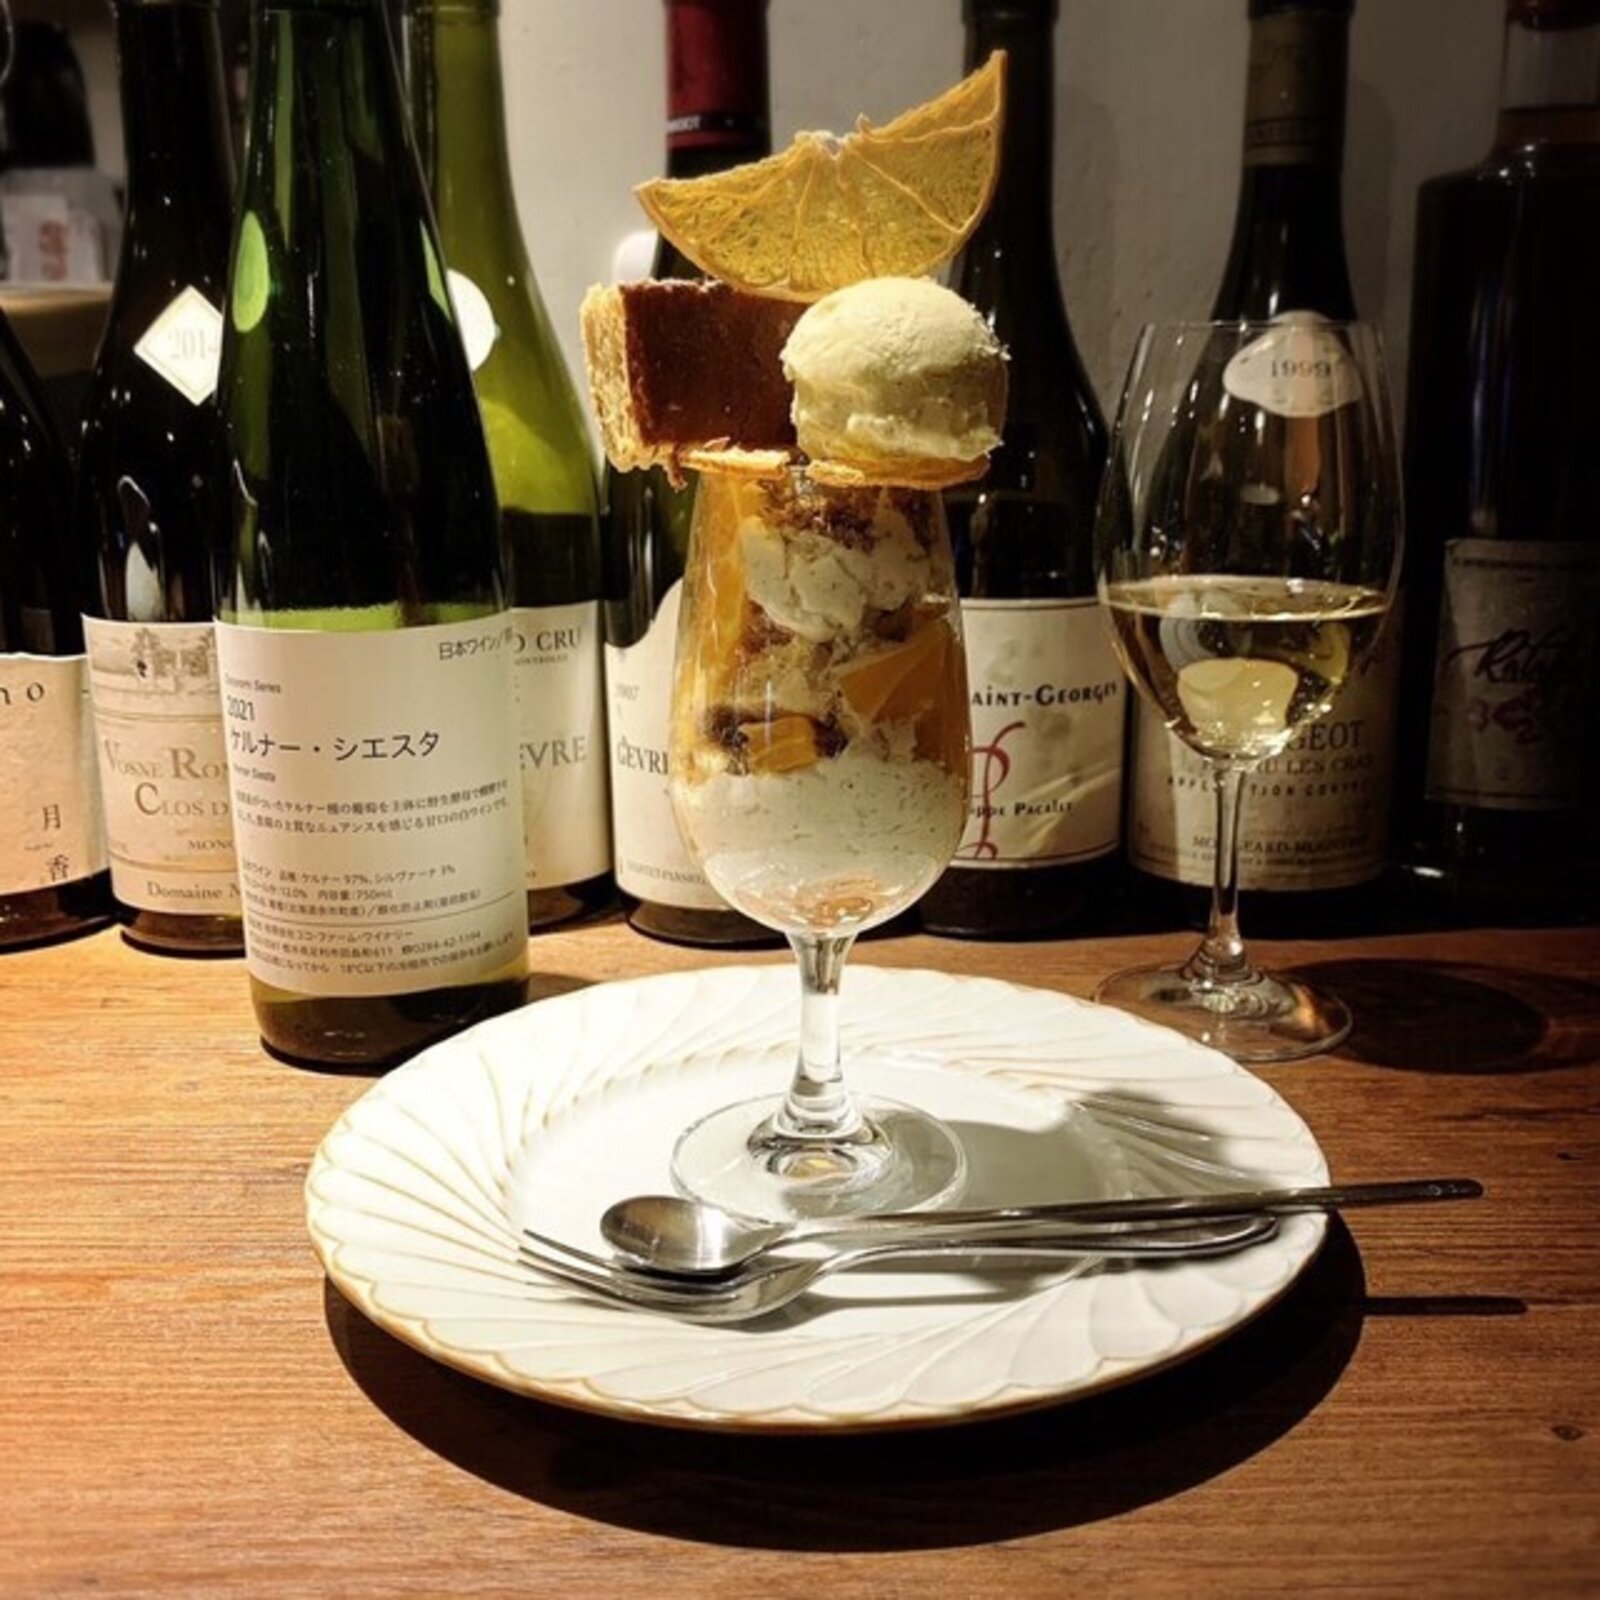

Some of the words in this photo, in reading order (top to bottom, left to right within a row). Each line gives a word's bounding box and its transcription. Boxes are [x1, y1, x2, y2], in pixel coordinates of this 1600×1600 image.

[1271, 358, 1332, 379] 1999
[536, 626, 582, 652] CRU
[227, 695, 255, 721] 2021
[135, 781, 205, 816] CLOS
[42, 804, 61, 831] 月
[146, 881, 223, 899] Domaine
